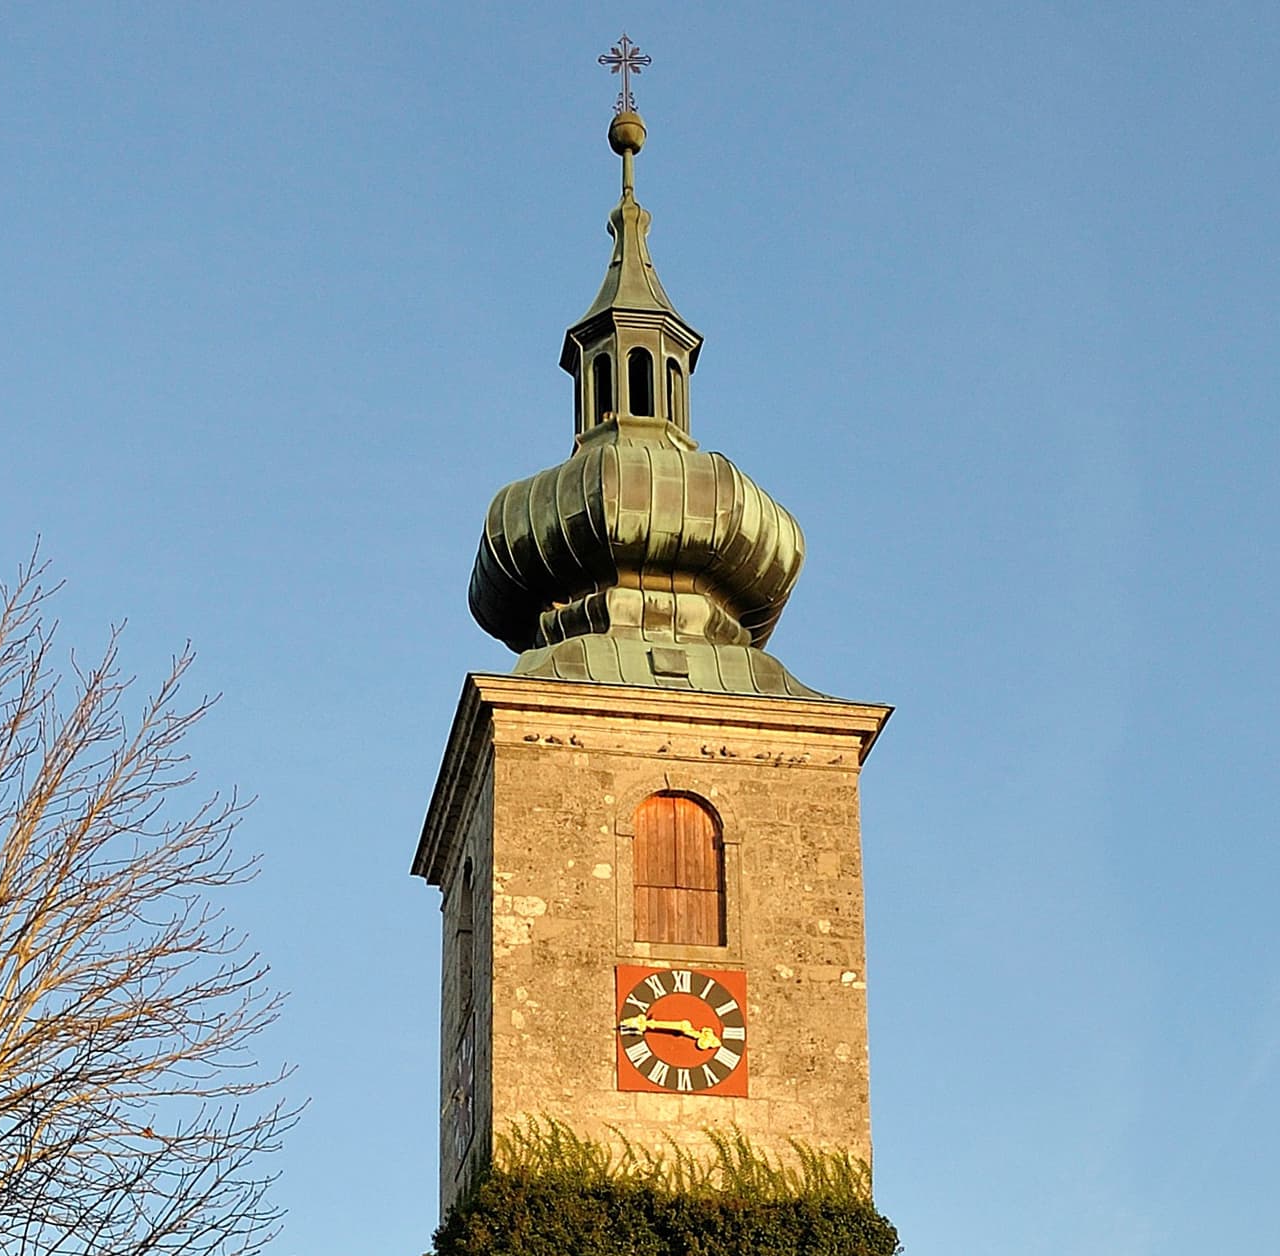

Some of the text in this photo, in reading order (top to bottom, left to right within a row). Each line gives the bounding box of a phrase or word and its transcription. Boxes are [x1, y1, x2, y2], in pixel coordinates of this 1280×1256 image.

[644, 974, 667, 999] XI
[671, 970, 692, 993] XII
[699, 978, 716, 1000] I
[625, 993, 650, 1013] X
[715, 999, 739, 1017] II
[722, 1027, 745, 1041] III
[624, 1040, 653, 1069] VIII
[647, 1060, 670, 1087] VII
[677, 1069, 693, 1091] VI
[702, 1064, 720, 1087] V
